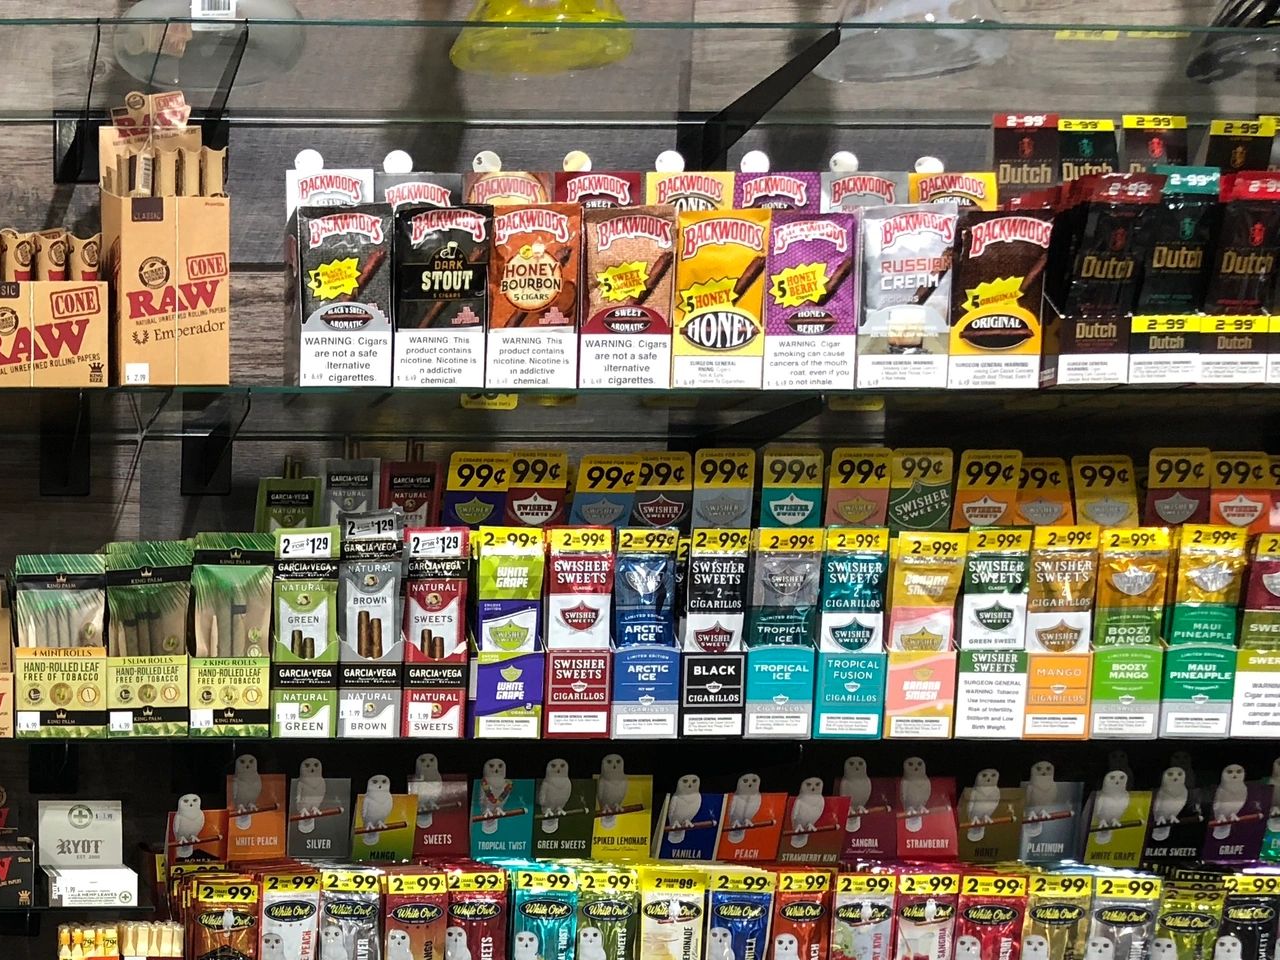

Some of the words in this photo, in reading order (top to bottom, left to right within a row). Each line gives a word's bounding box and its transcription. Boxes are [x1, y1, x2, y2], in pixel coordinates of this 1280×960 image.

[999, 164, 1052, 184] Dutch
[300, 175, 361, 201] BACKWOODS
[567, 176, 633, 203] BACKWOODS
[743, 177, 807, 206] BACKWOODS
[495, 213, 570, 246] BACKWOODS
[683, 219, 765, 260] BACKWOODS
[969, 217, 1053, 259] BACKWOODS
[1153, 247, 1203, 269] Dutch
[190, 258, 223, 277] CONE
[434, 261, 463, 270] DARK
[505, 263, 558, 277] HONEY
[881, 258, 952, 274] RUSSIAN
[421, 270, 474, 289] STOUT
[881, 275, 939, 290] CREAM
[502, 279, 562, 293] BOURBON
[126, 280, 220, 319] RAW
[521, 293, 549, 302] CIGARS
[615, 309, 642, 319] SWEET
[611, 321, 645, 332] AROMATIC
[972, 316, 1021, 329] ORIGINAL
[154, 321, 225, 344] Emperador
[687, 314, 754, 348] HONEY
[358, 337, 387, 348] Cigars
[512, 459, 561, 482] 99¢
[966, 461, 1015, 484] 99¢
[353, 597, 387, 606] BROWN
[414, 616, 453, 624] SWEETS
[40, 650, 63, 658] MINI
[64, 650, 92, 658] ROLLS
[24, 663, 75, 673] HAND-ROLLED
[78, 663, 100, 672] LEAF
[554, 660, 606, 669] SWISHER
[627, 665, 669, 674] ARCTIC
[1111, 664, 1148, 672] BOOZY
[556, 669, 601, 679] SWEETS
[693, 665, 736, 676] BLACK
[833, 671, 873, 680] FUSION
[1169, 672, 1233, 680] PINEAPPLE
[58, 673, 99, 681] TOBACCO
[285, 722, 324, 731] GREEN
[306, 839, 331, 849] SILVER
[423, 834, 451, 845] SWEETS
[593, 837, 613, 846] SPIKED
[616, 837, 647, 846] LEMONADE
[906, 839, 949, 850] STRAWBERRY
[734, 849, 759, 859] PEACH
